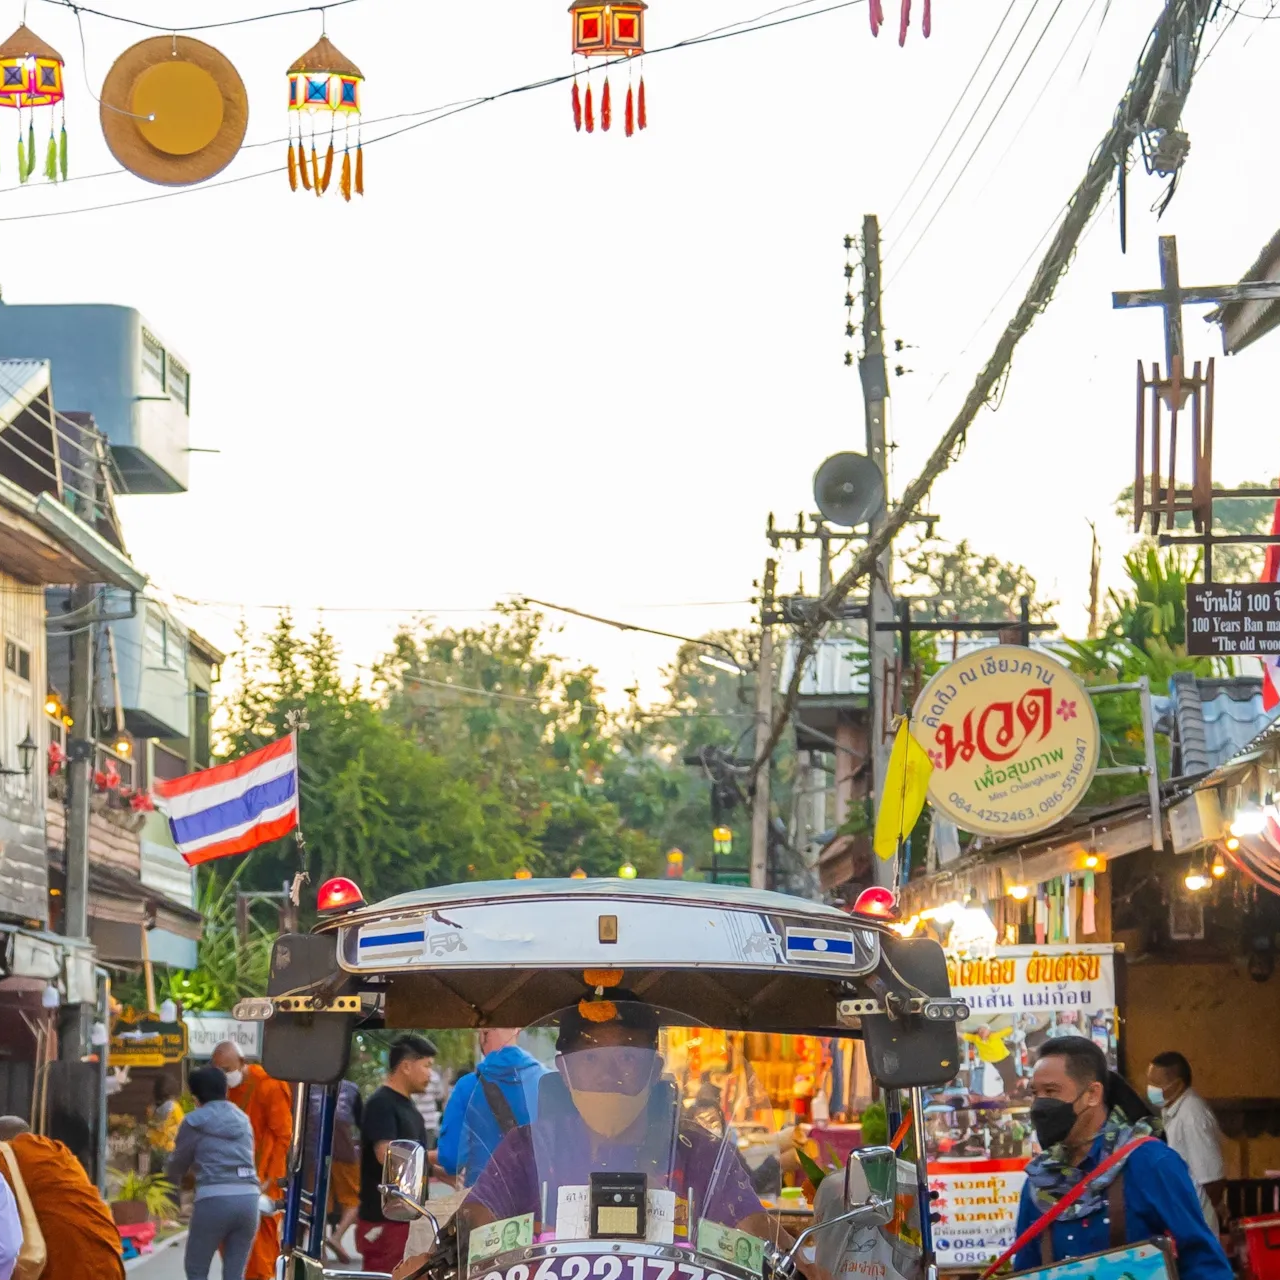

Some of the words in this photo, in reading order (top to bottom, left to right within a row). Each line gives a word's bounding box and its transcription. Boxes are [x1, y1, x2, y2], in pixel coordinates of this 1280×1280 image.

[1247, 593, 1271, 612] 100
[1192, 617, 1210, 633] 100
[1212, 617, 1241, 633] Years
[1244, 617, 1264, 632] Ban
[1239, 636, 1256, 651] old
[922, 684, 958, 729] คิดถึง
[959, 667, 979, 686] ณ
[980, 656, 1056, 686] เชียงคาน
[934, 687, 1053, 772] นวด
[974, 747, 1065, 792] เพื่อสุขภาพ
